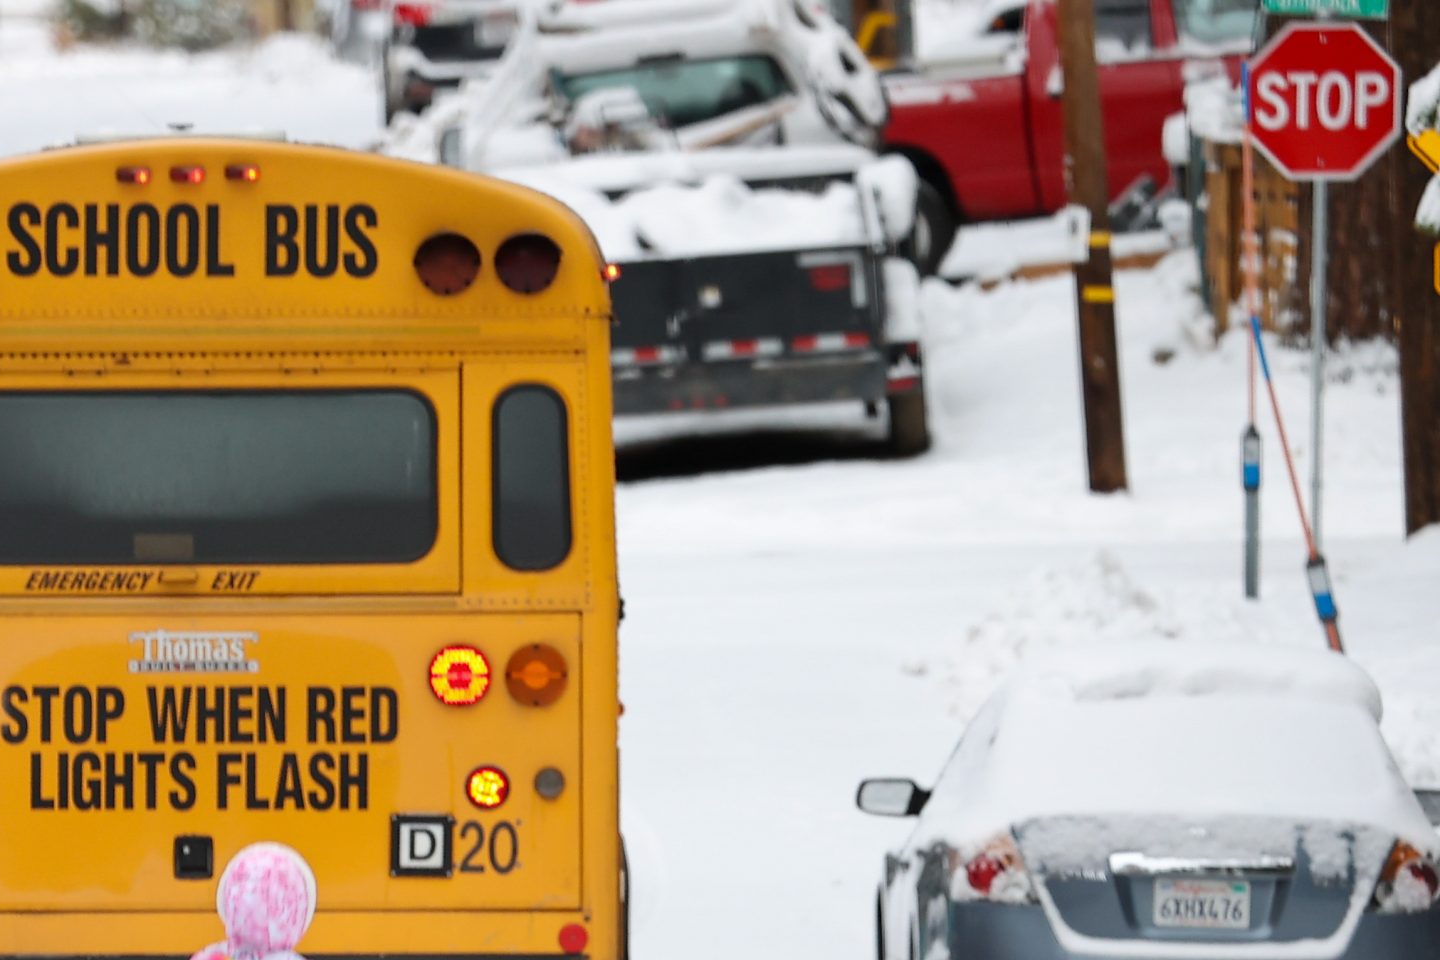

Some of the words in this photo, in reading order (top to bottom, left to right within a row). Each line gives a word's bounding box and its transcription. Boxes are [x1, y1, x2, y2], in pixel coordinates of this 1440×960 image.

[1254, 70, 1389, 131] STOP
[6, 202, 235, 278] SCHOOL
[265, 203, 378, 278] BUS
[25, 570, 153, 590] EMERGENCY
[212, 569, 260, 591] EXIT
[129, 628, 259, 662] Thomas
[0, 685, 125, 744] STOP
[147, 686, 286, 743] WHEN
[306, 686, 399, 743] RED
[30, 753, 196, 811] LIGHTS
[217, 753, 369, 811] FLASH
[409, 828, 436, 861] D
[460, 820, 519, 875] 20
